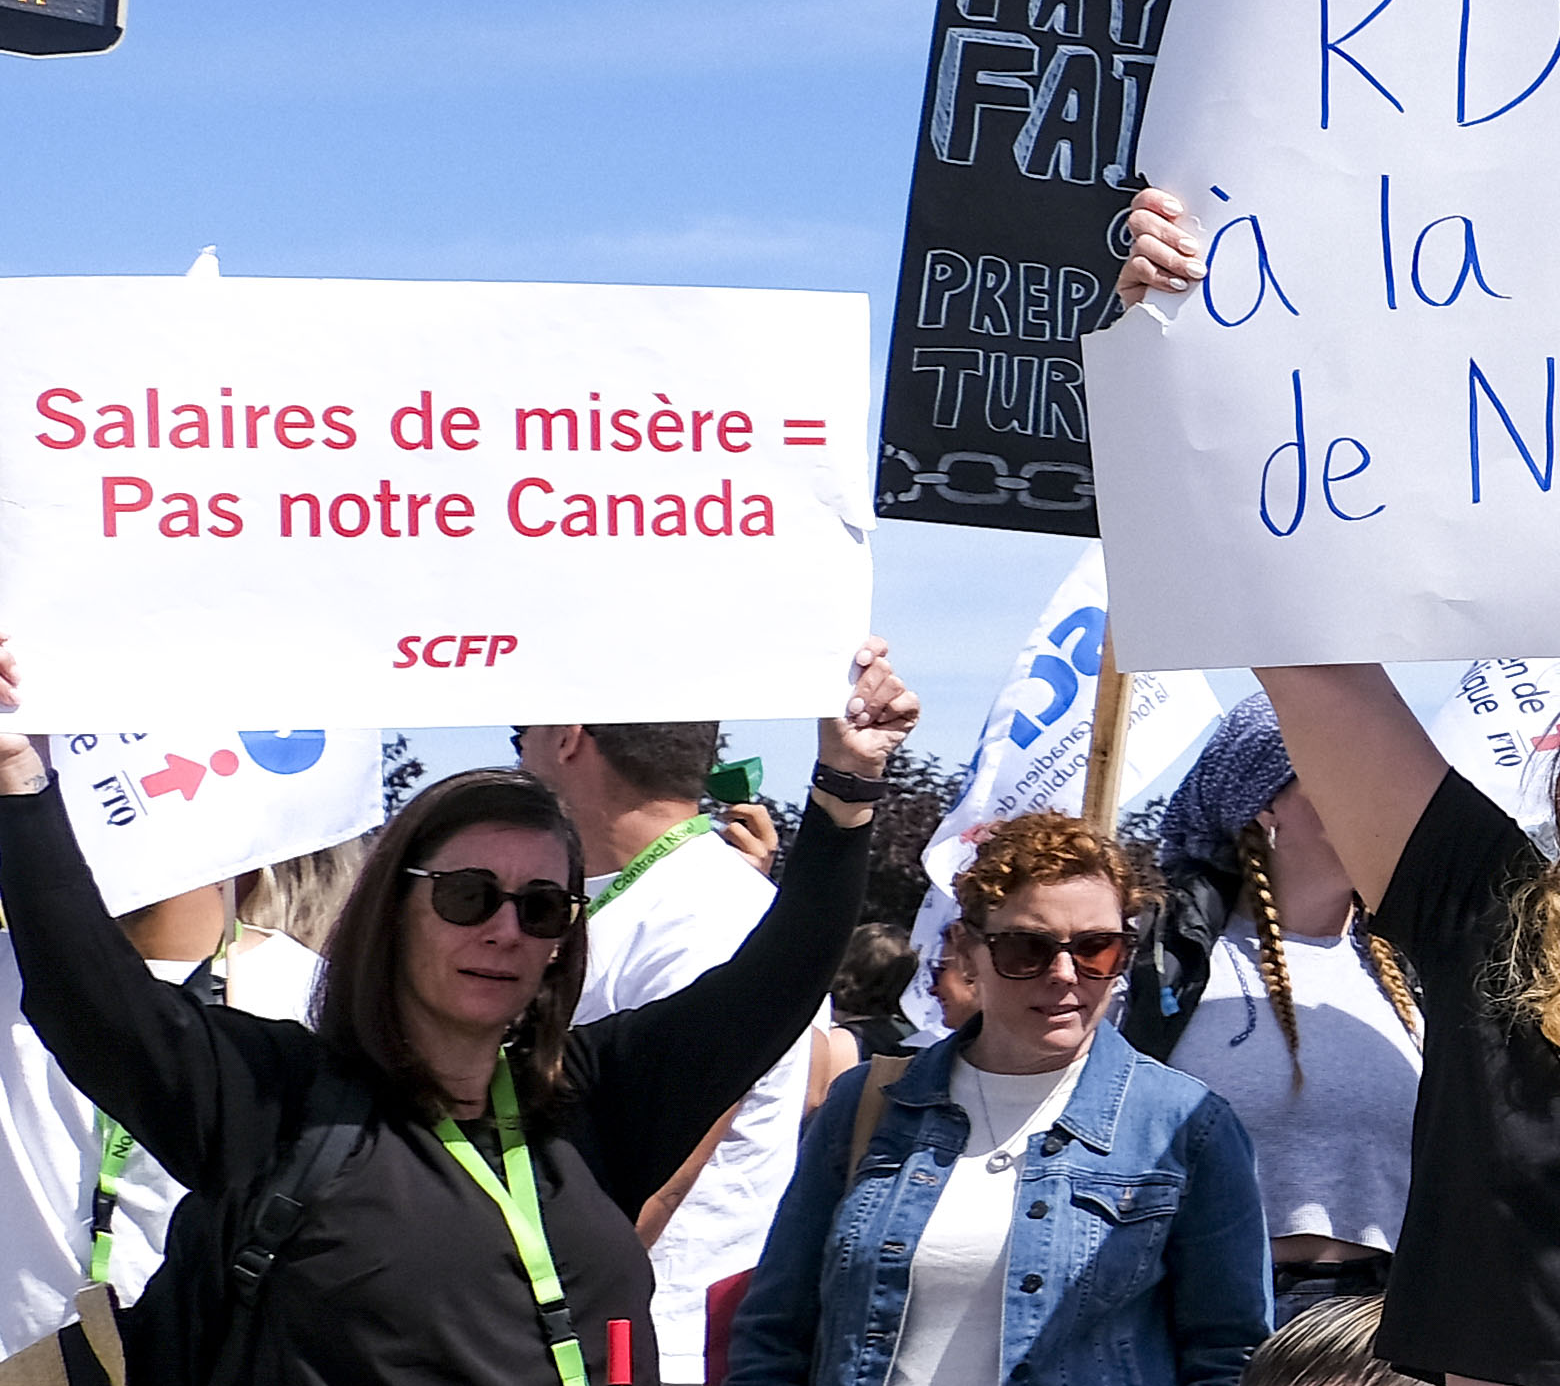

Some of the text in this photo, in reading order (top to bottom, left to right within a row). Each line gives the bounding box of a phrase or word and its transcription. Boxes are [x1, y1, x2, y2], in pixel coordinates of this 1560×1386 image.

[1202, 186, 1300, 329] à
[1380, 173, 1507, 312] la
[35, 386, 359, 450] Salaires
[390, 390, 481, 451] de
[516, 392, 754, 453] misère
[1258, 367, 1387, 538] de
[101, 475, 777, 539] Pas notre Canada
[392, 632, 519, 671] SCFP
[1511, 682, 1551, 714] de
[112, 1134, 134, 1160] No
